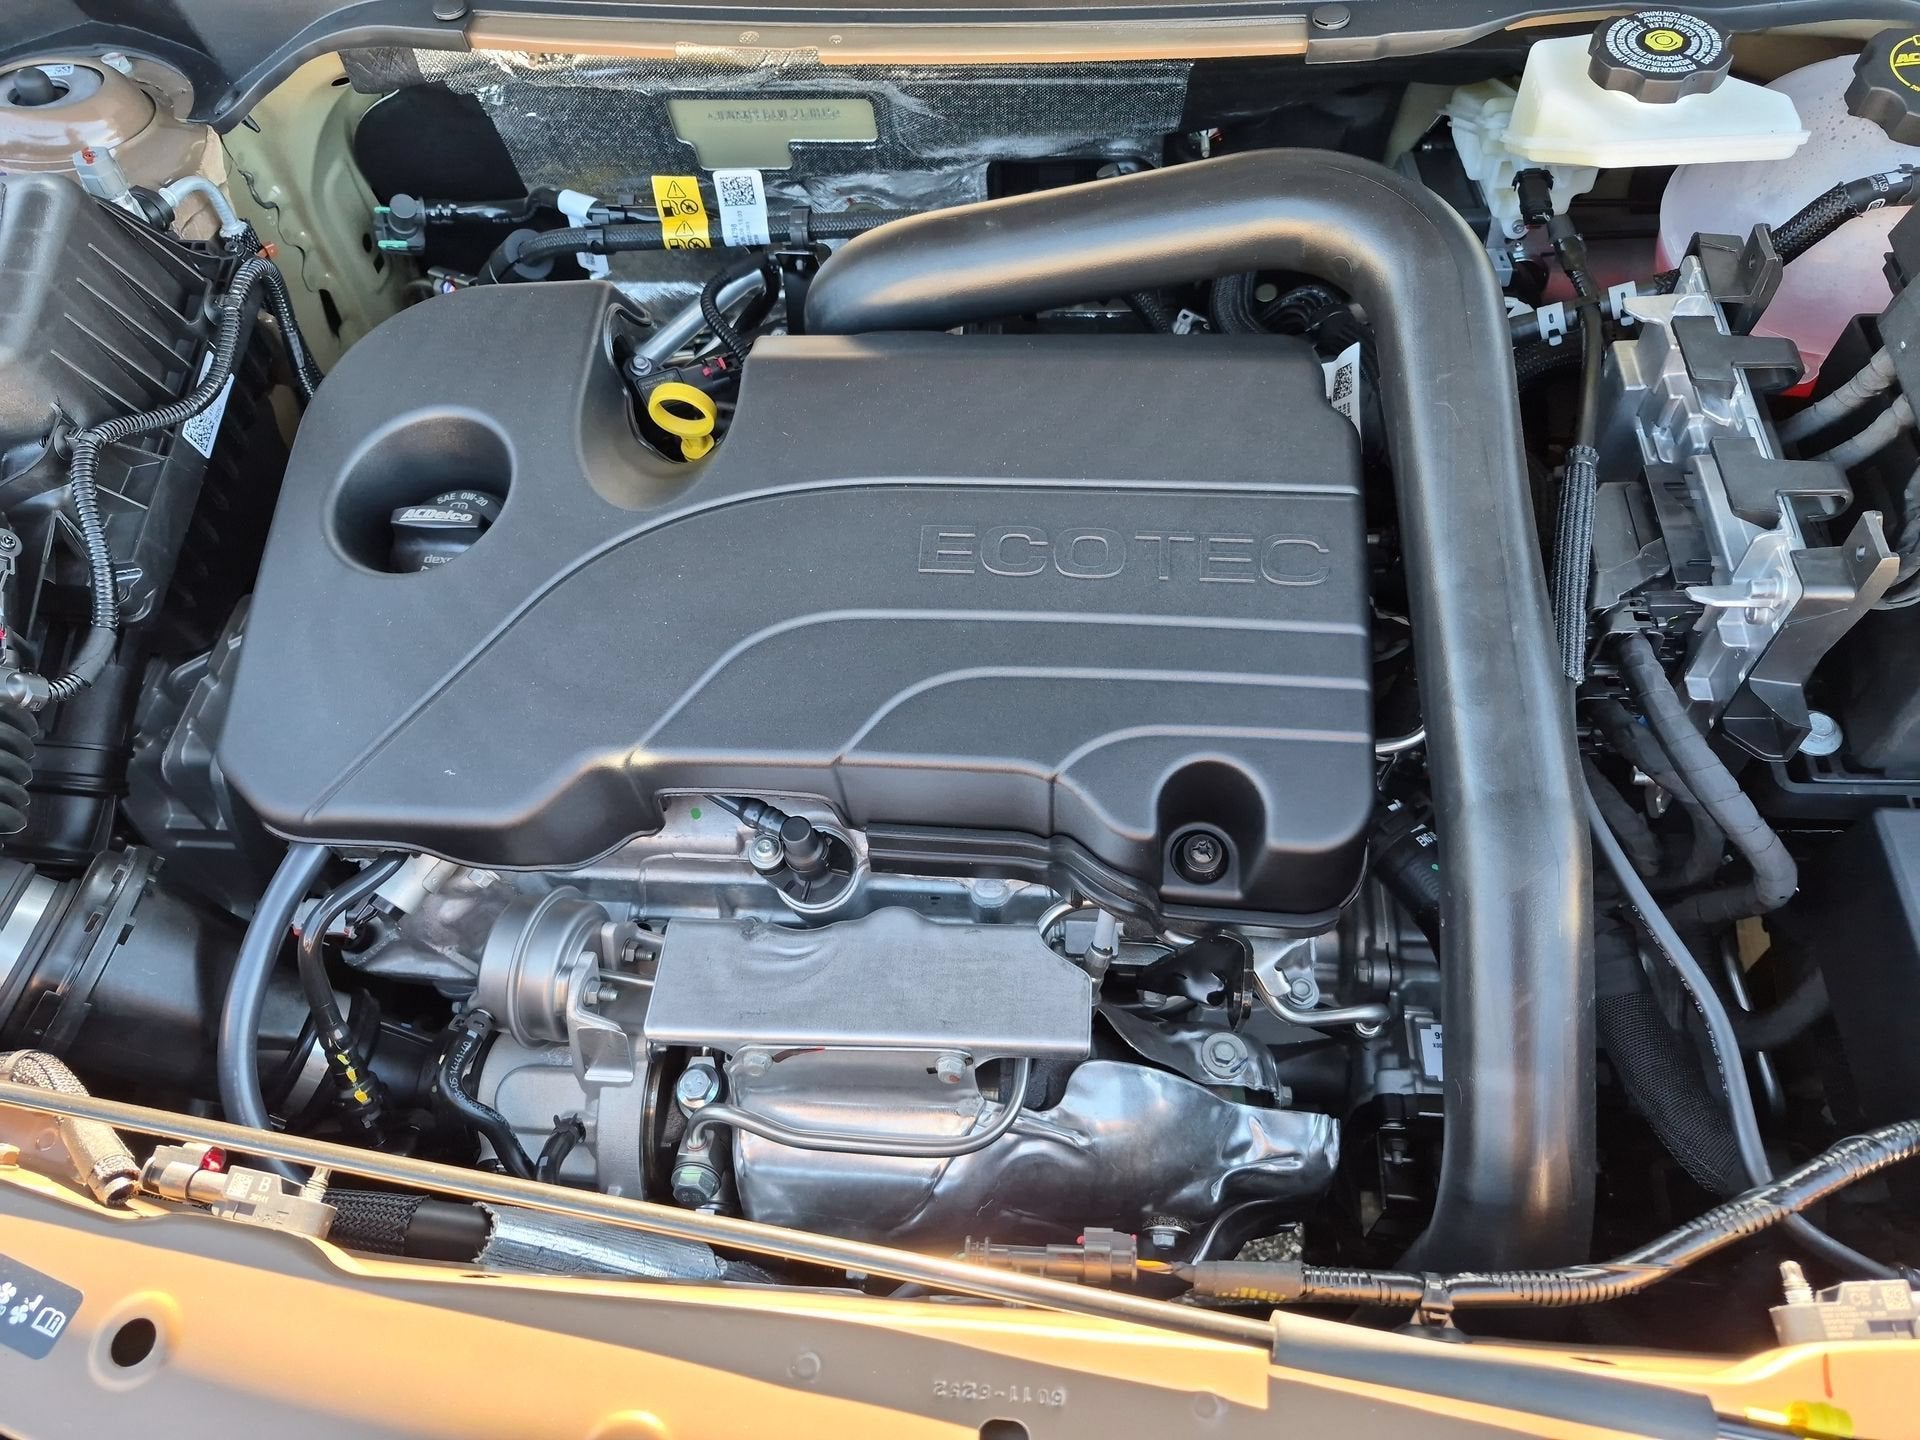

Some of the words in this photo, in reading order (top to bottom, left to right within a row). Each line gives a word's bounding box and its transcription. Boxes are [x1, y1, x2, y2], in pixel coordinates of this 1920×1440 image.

[1681, 14, 1708, 28] SEALED
[436, 492, 457, 505] SAE
[460, 492, 489, 507] 0W-20
[400, 508, 473, 523] ACDelco
[918, 524, 1330, 586] ECOTEC
[258, 1176, 272, 1193] B
